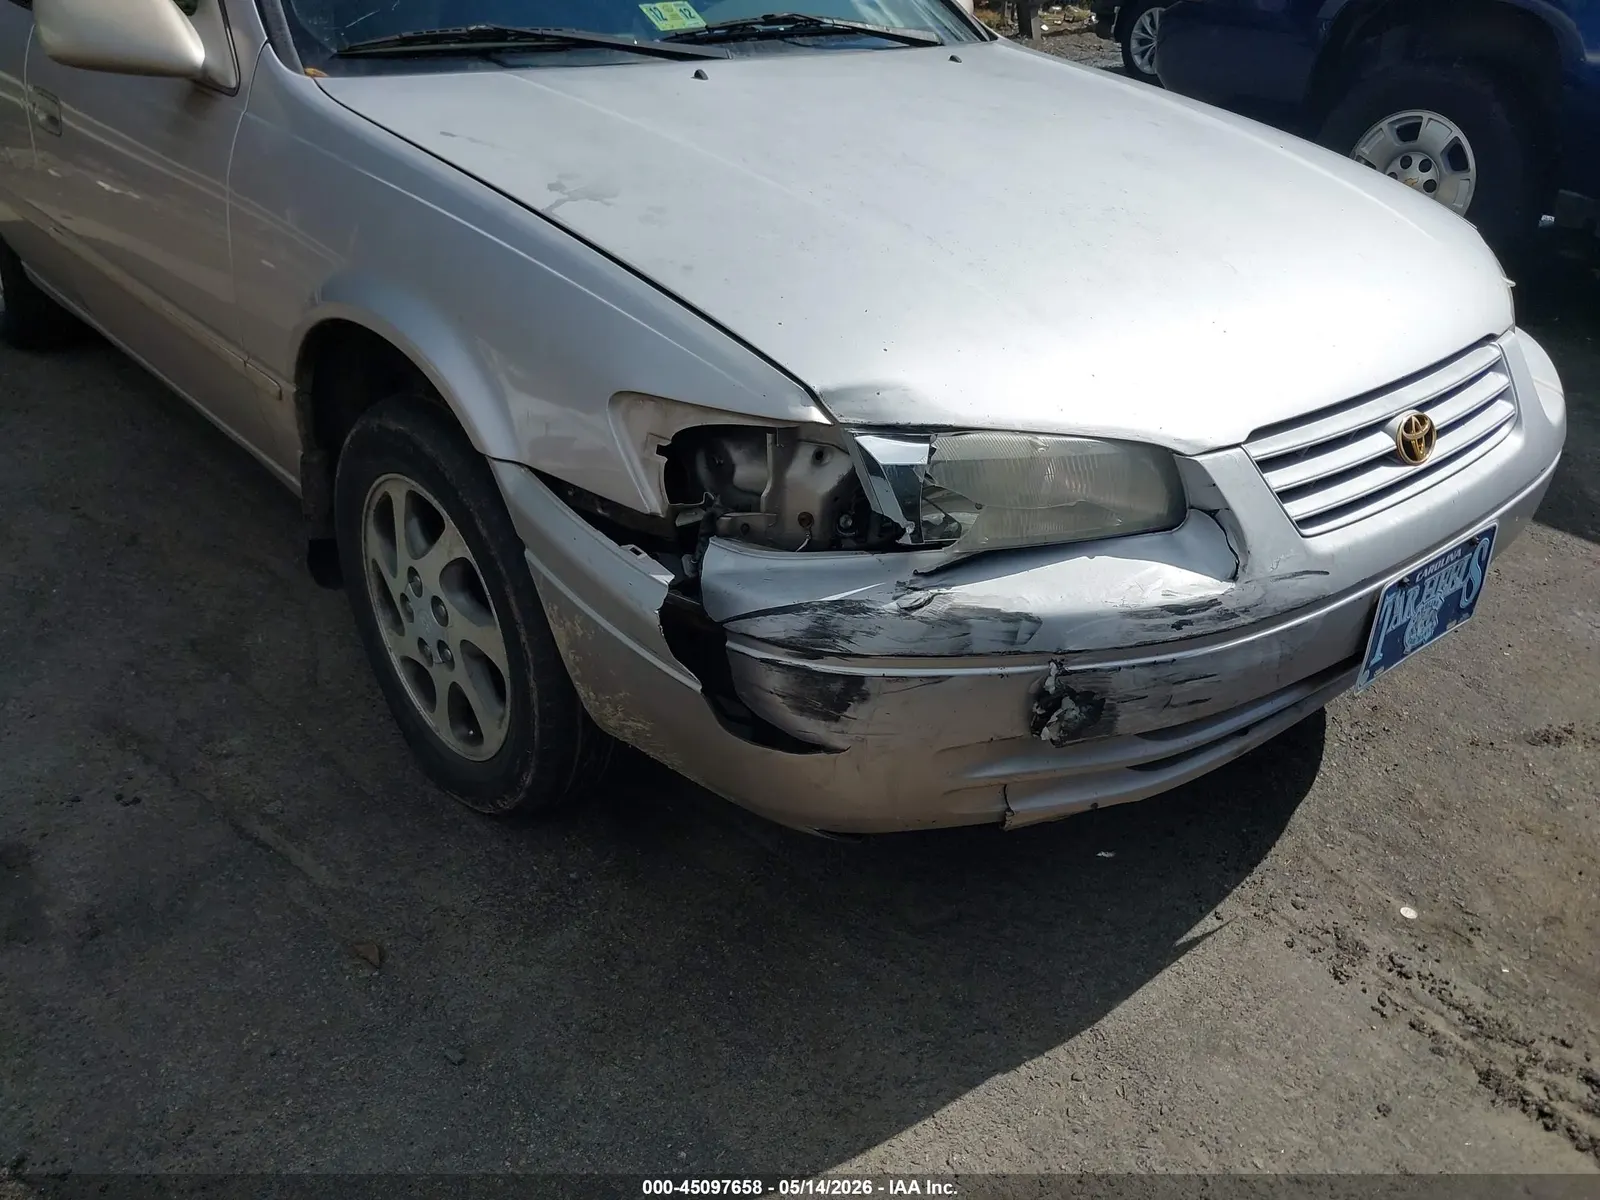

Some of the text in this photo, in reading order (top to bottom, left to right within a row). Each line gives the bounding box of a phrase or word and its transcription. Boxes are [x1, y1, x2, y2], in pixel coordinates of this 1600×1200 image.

[649, 7, 696, 21] 12 12
[1415, 548, 1462, 583] CAROLINA
[1369, 585, 1420, 667] TAR
